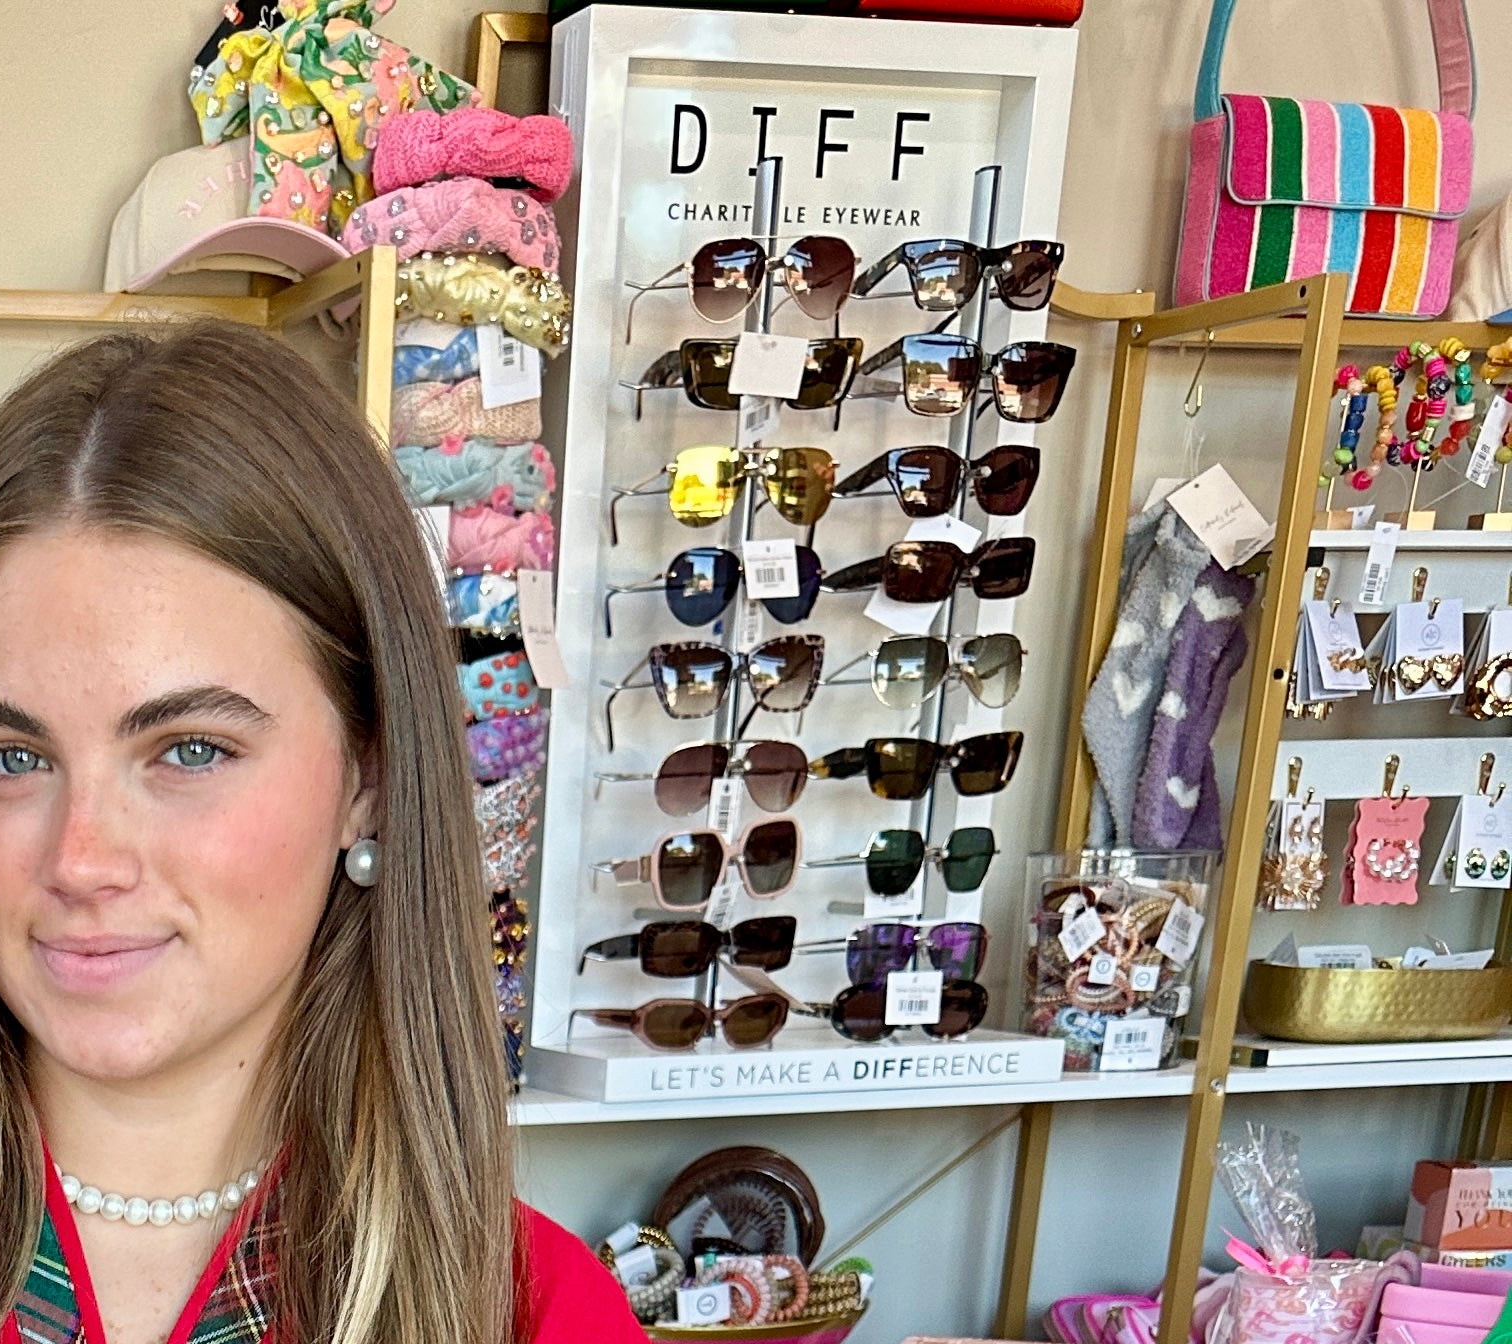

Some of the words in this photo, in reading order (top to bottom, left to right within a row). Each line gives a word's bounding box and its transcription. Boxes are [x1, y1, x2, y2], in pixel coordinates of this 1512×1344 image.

[670, 103, 931, 181] DIFF
[668, 203, 806, 224] CHARITLE
[822, 207, 921, 227] EYEWEAR
[651, 1064, 725, 1091] LET'S
[737, 1061, 813, 1086] MAKE
[823, 1060, 841, 1082] A
[852, 1052, 1020, 1080] DIFFERENCE
